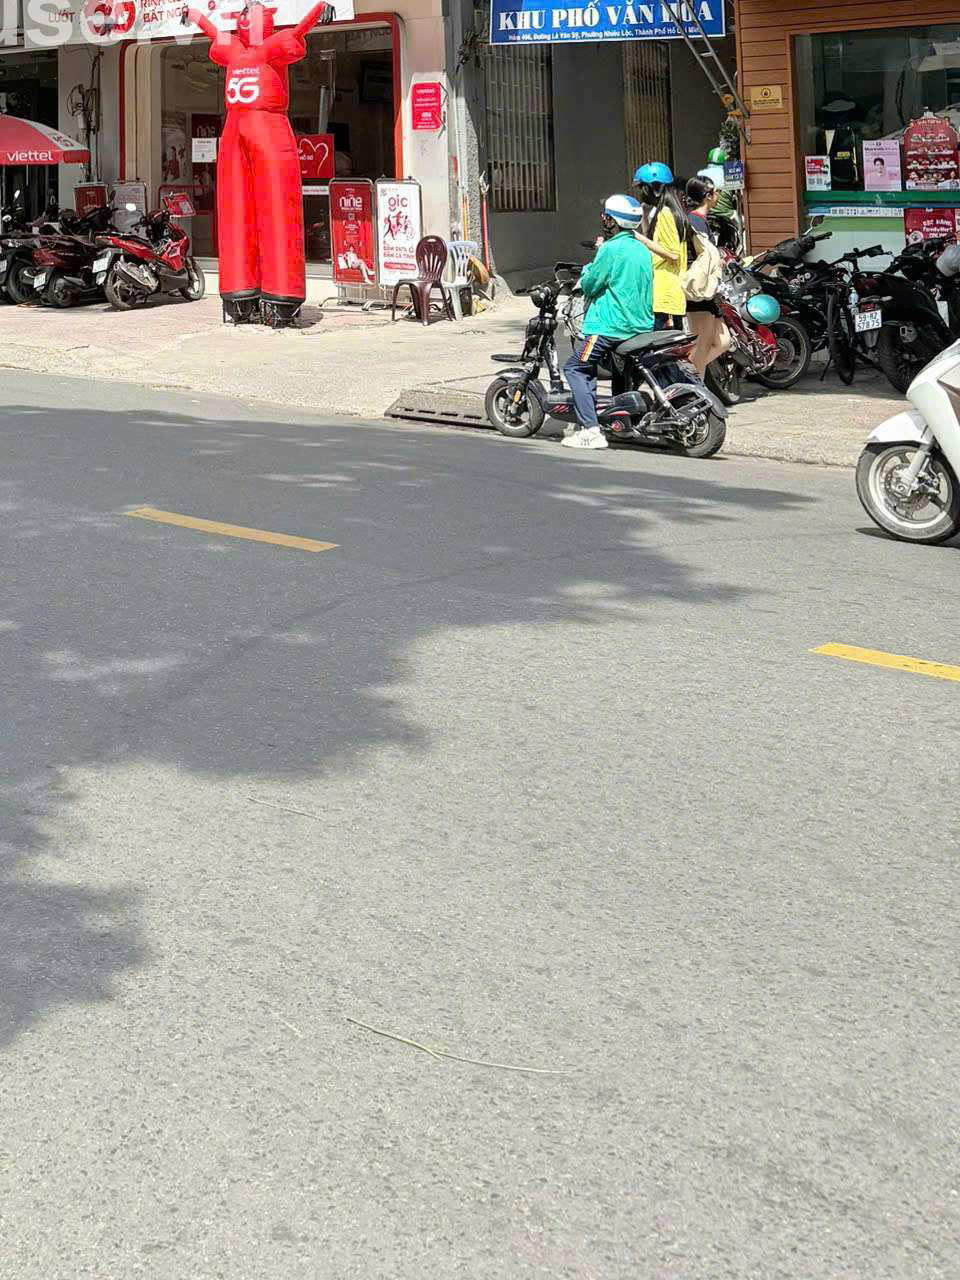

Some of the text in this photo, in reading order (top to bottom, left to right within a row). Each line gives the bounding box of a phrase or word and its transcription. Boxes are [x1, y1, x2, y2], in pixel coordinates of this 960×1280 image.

[143, 6, 165, 23] BẤT
[498, 10, 546, 31] KHU
[226, 77, 260, 104] 5G
[6, 151, 54, 162] viettel
[387, 194, 408, 212] gic
